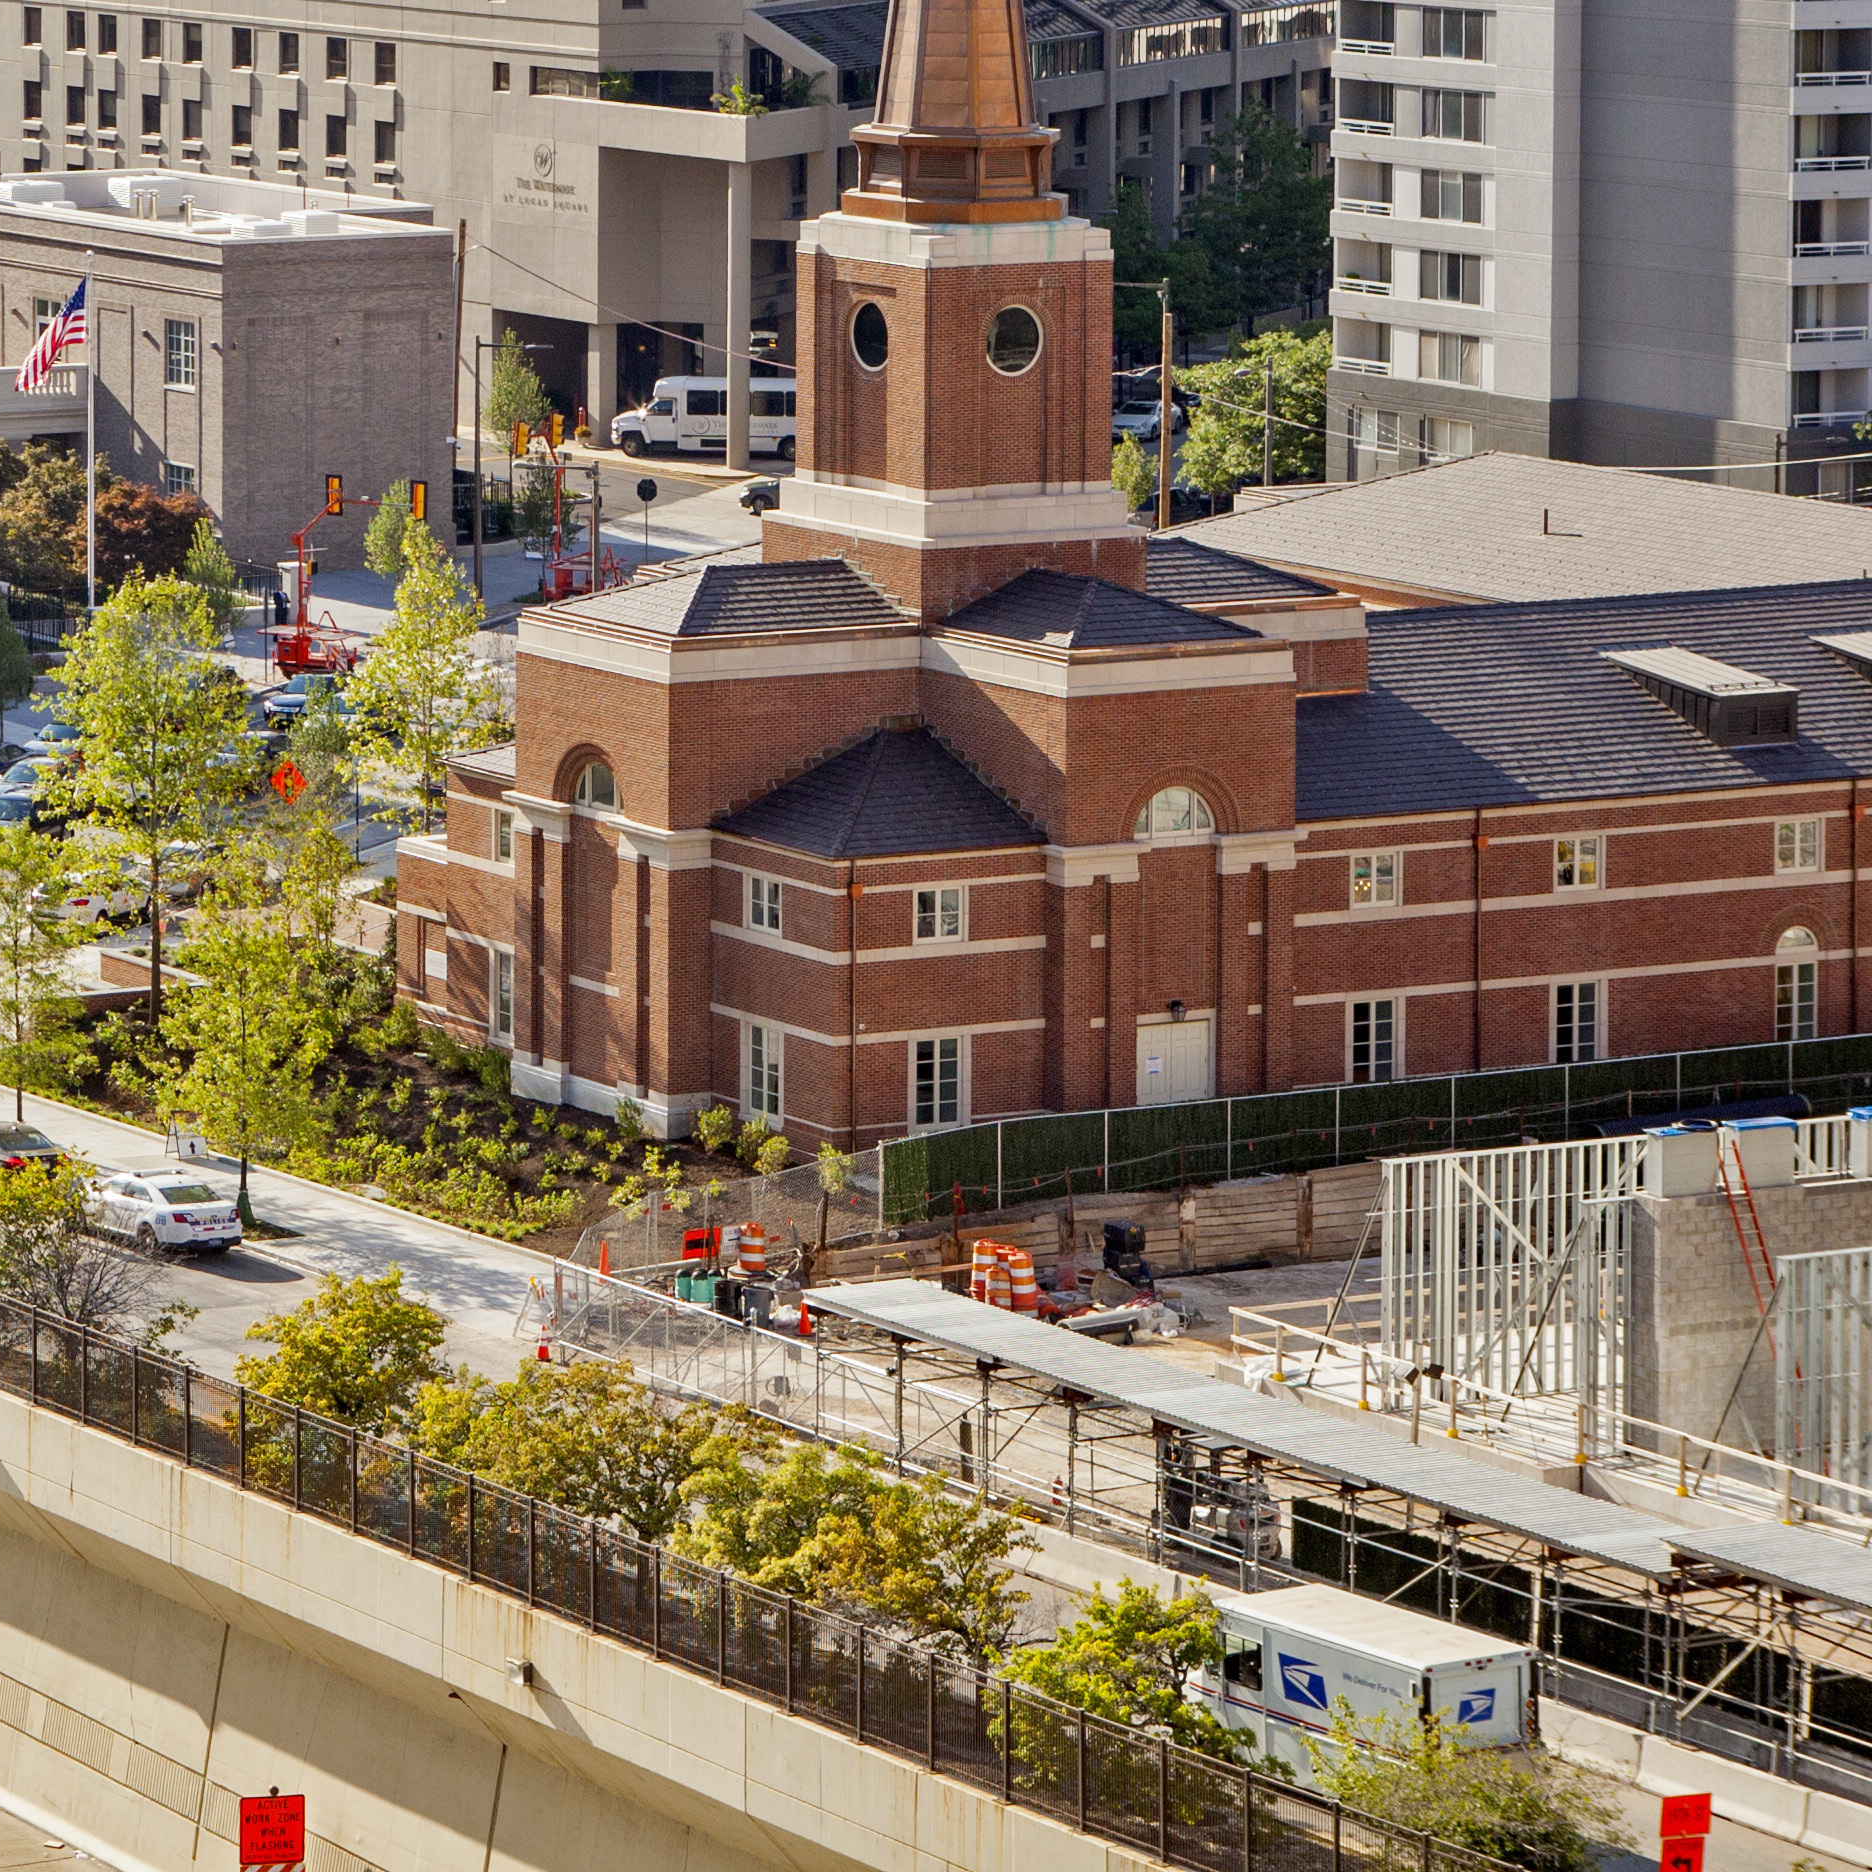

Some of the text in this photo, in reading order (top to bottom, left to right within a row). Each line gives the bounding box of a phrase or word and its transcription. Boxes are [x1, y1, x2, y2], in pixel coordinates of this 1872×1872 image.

[257, 1799, 288, 1810] ACTIVE
[245, 1811, 300, 1824] WORK ZONE
[261, 1827, 286, 1837] WHEN
[250, 1840, 295, 1851] FLASHING
